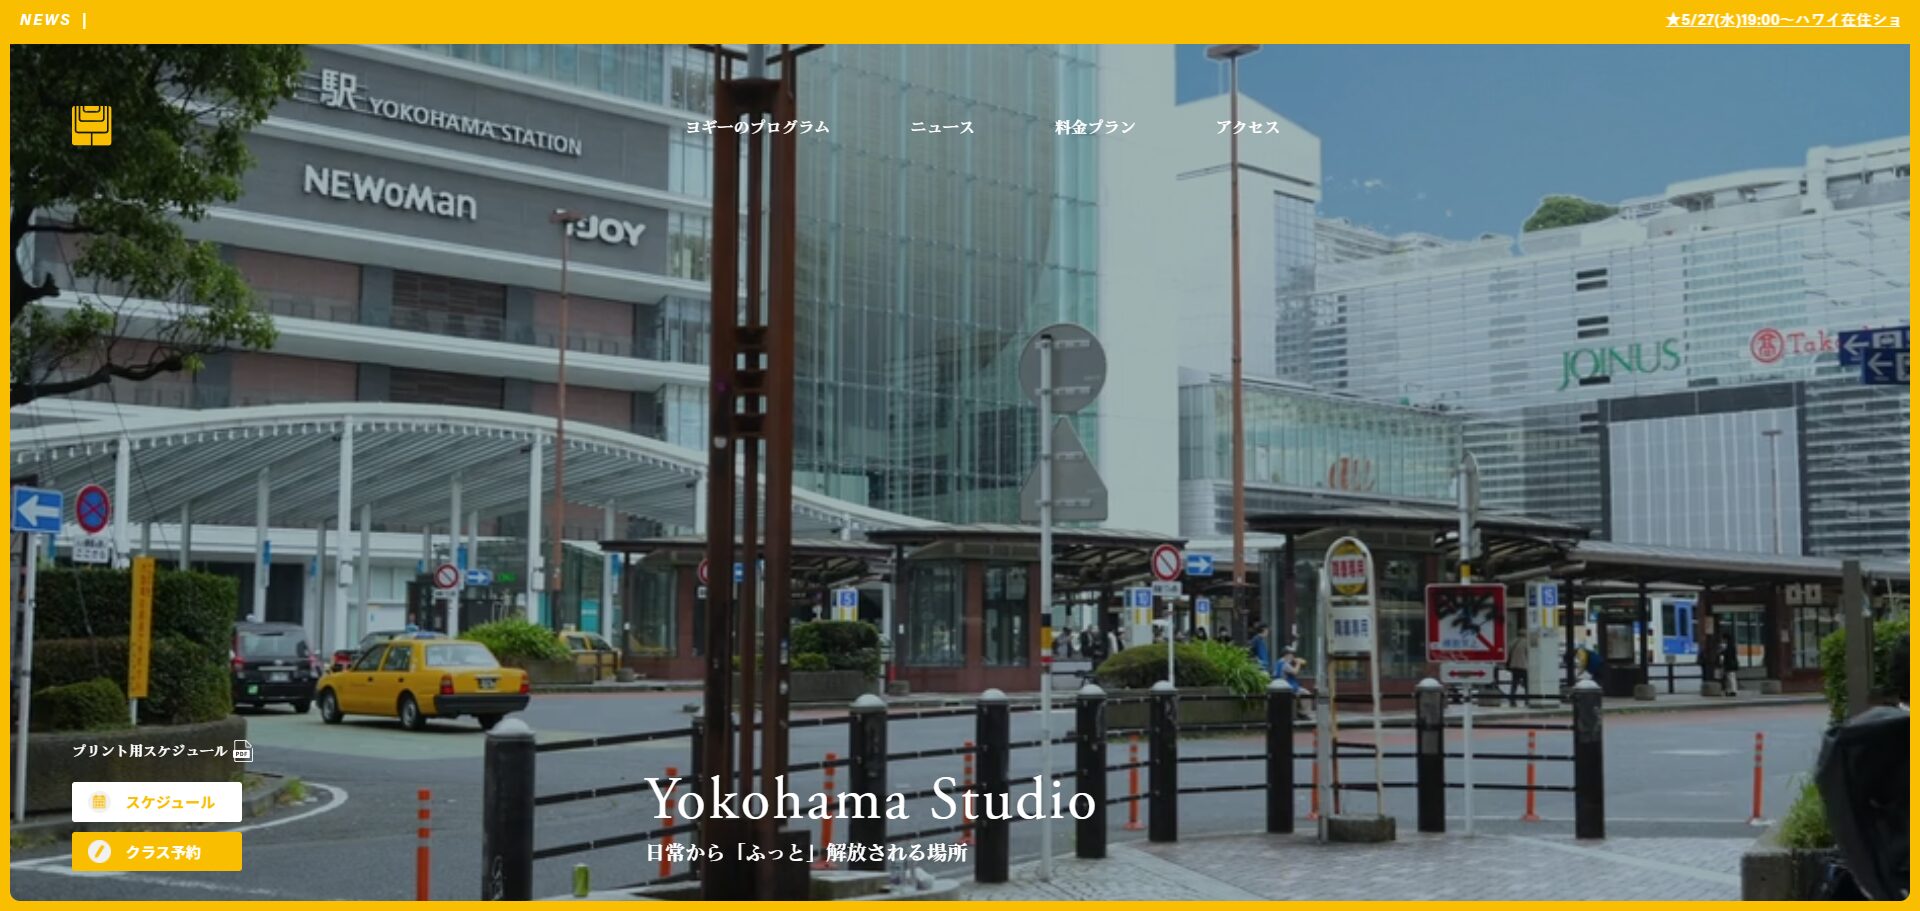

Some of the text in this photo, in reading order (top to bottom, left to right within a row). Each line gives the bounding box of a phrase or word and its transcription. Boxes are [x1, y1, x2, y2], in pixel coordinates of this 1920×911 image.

[370, 97, 583, 156] YOKOHAMA STATION
[1557, 338, 1681, 391] JOINUS
